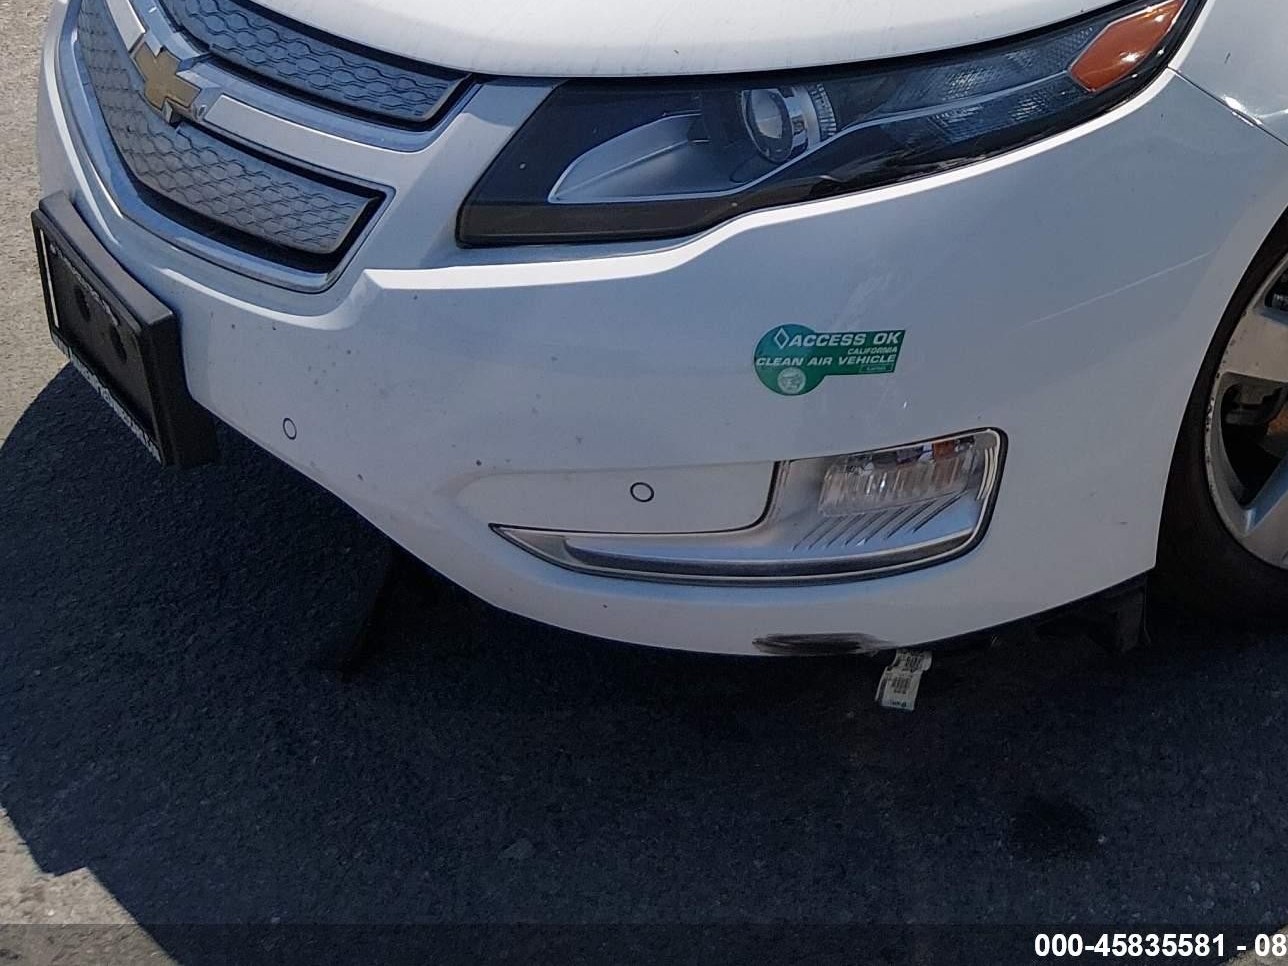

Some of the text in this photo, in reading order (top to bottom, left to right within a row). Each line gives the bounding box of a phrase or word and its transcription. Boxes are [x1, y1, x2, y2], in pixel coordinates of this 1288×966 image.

[788, 331, 901, 347] ACCESS OK
[847, 346, 898, 355] CALIFORNIA
[755, 354, 897, 367] CLEAN AIR VEHICLE
